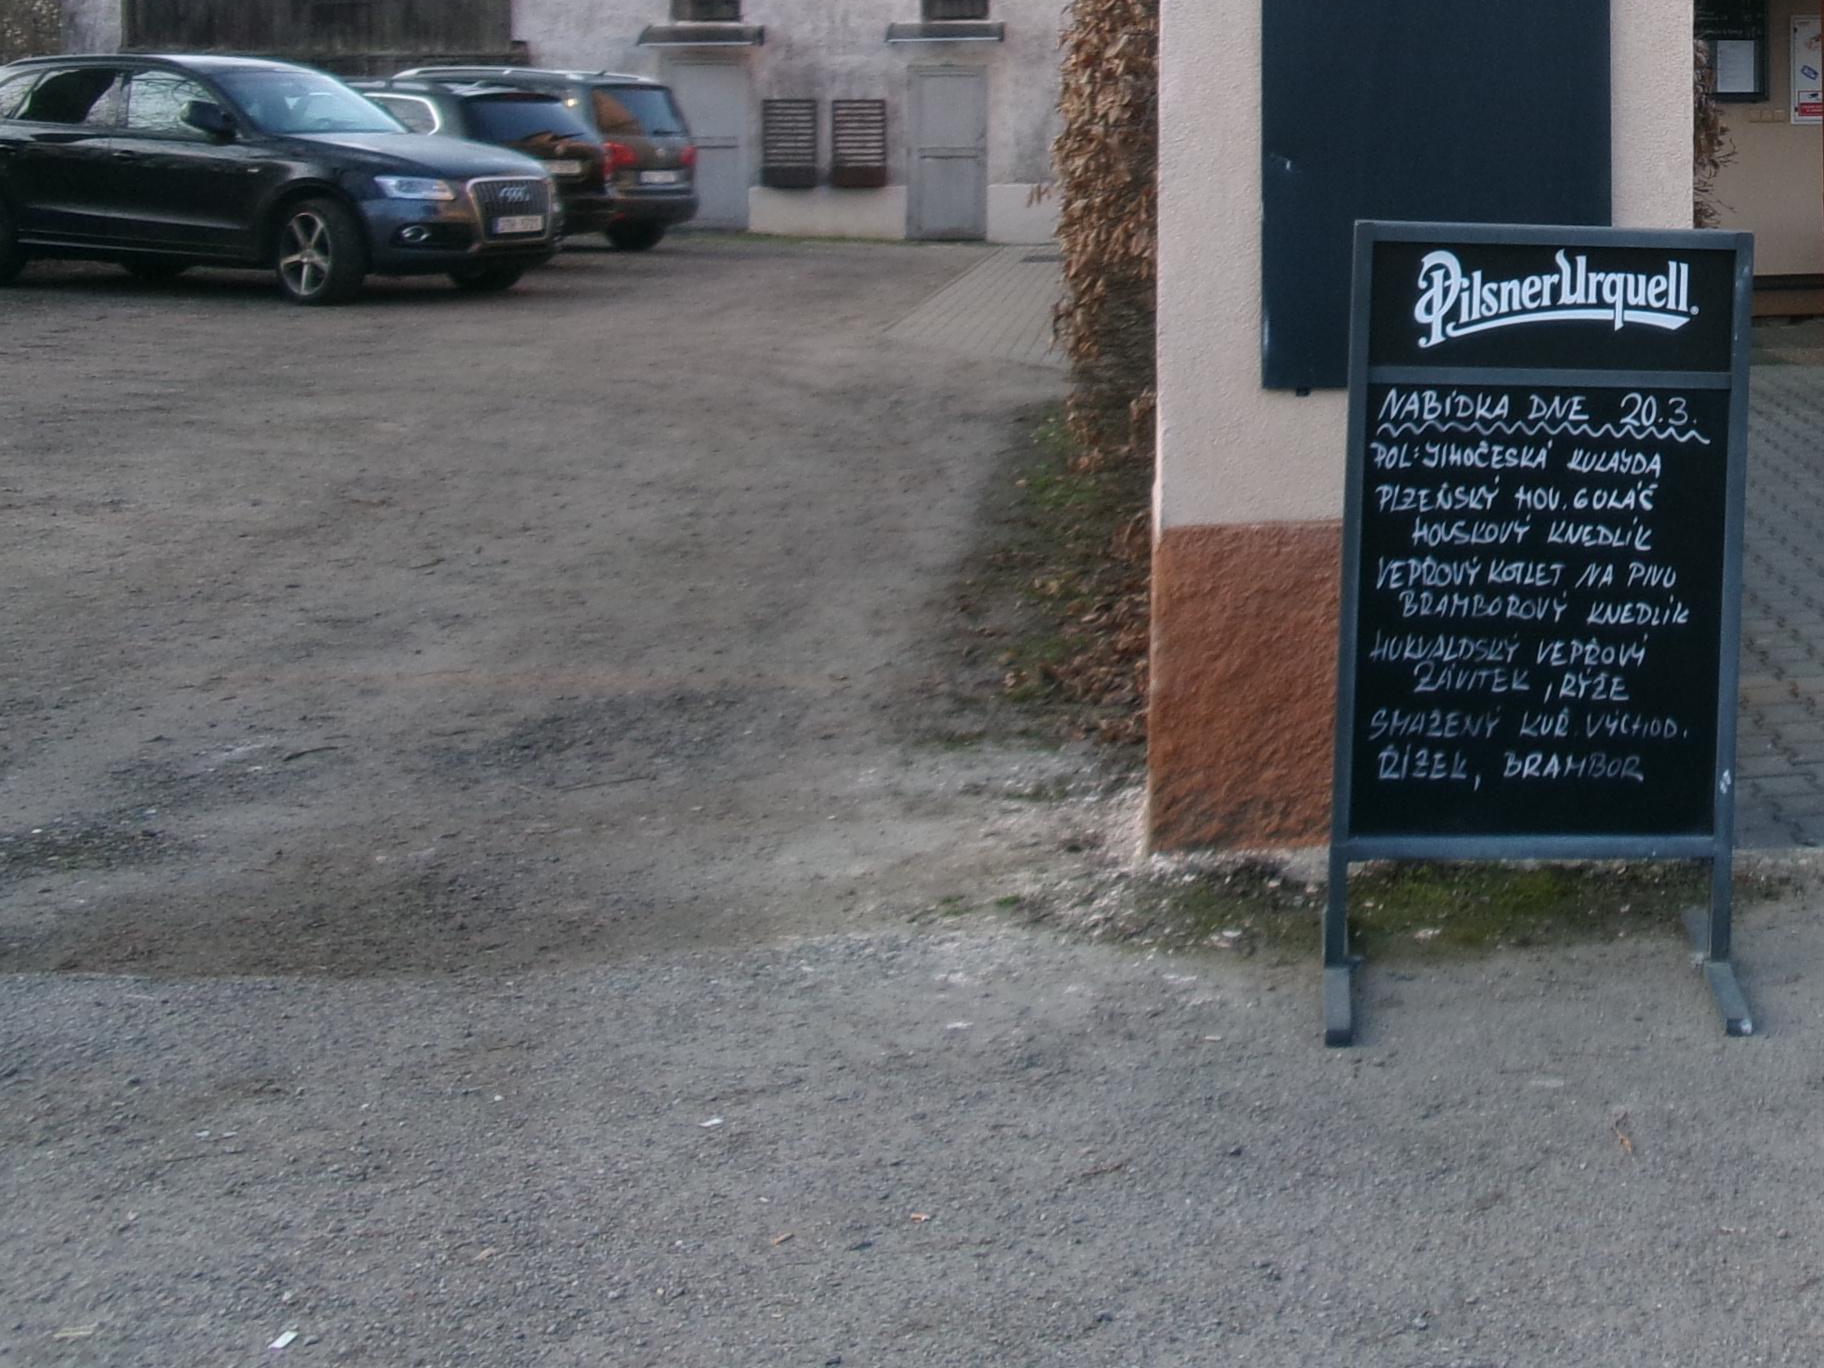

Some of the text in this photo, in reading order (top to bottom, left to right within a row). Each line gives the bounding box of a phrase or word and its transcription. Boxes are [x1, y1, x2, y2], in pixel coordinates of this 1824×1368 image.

[1413, 248, 1690, 348] Pilsner Urquell
[1378, 388, 1698, 426] NABÍDKA DNE 20.3.
[1375, 475, 1501, 512] PLZEŇSKÝ
[1514, 484, 1567, 511] HOV.
[1412, 513, 1653, 551] HOUSKOVÝ KNEDLÍK
[1376, 554, 1677, 589] VEPŘOVÝ KOTLET NA PIVU
[1398, 589, 1690, 625] BRAMBOROVÝ KNEDLÍK
[1369, 629, 1649, 668] HUKVALDSKÝ VEPŘOVÝ
[1502, 750, 1645, 783] BRAMBOR
